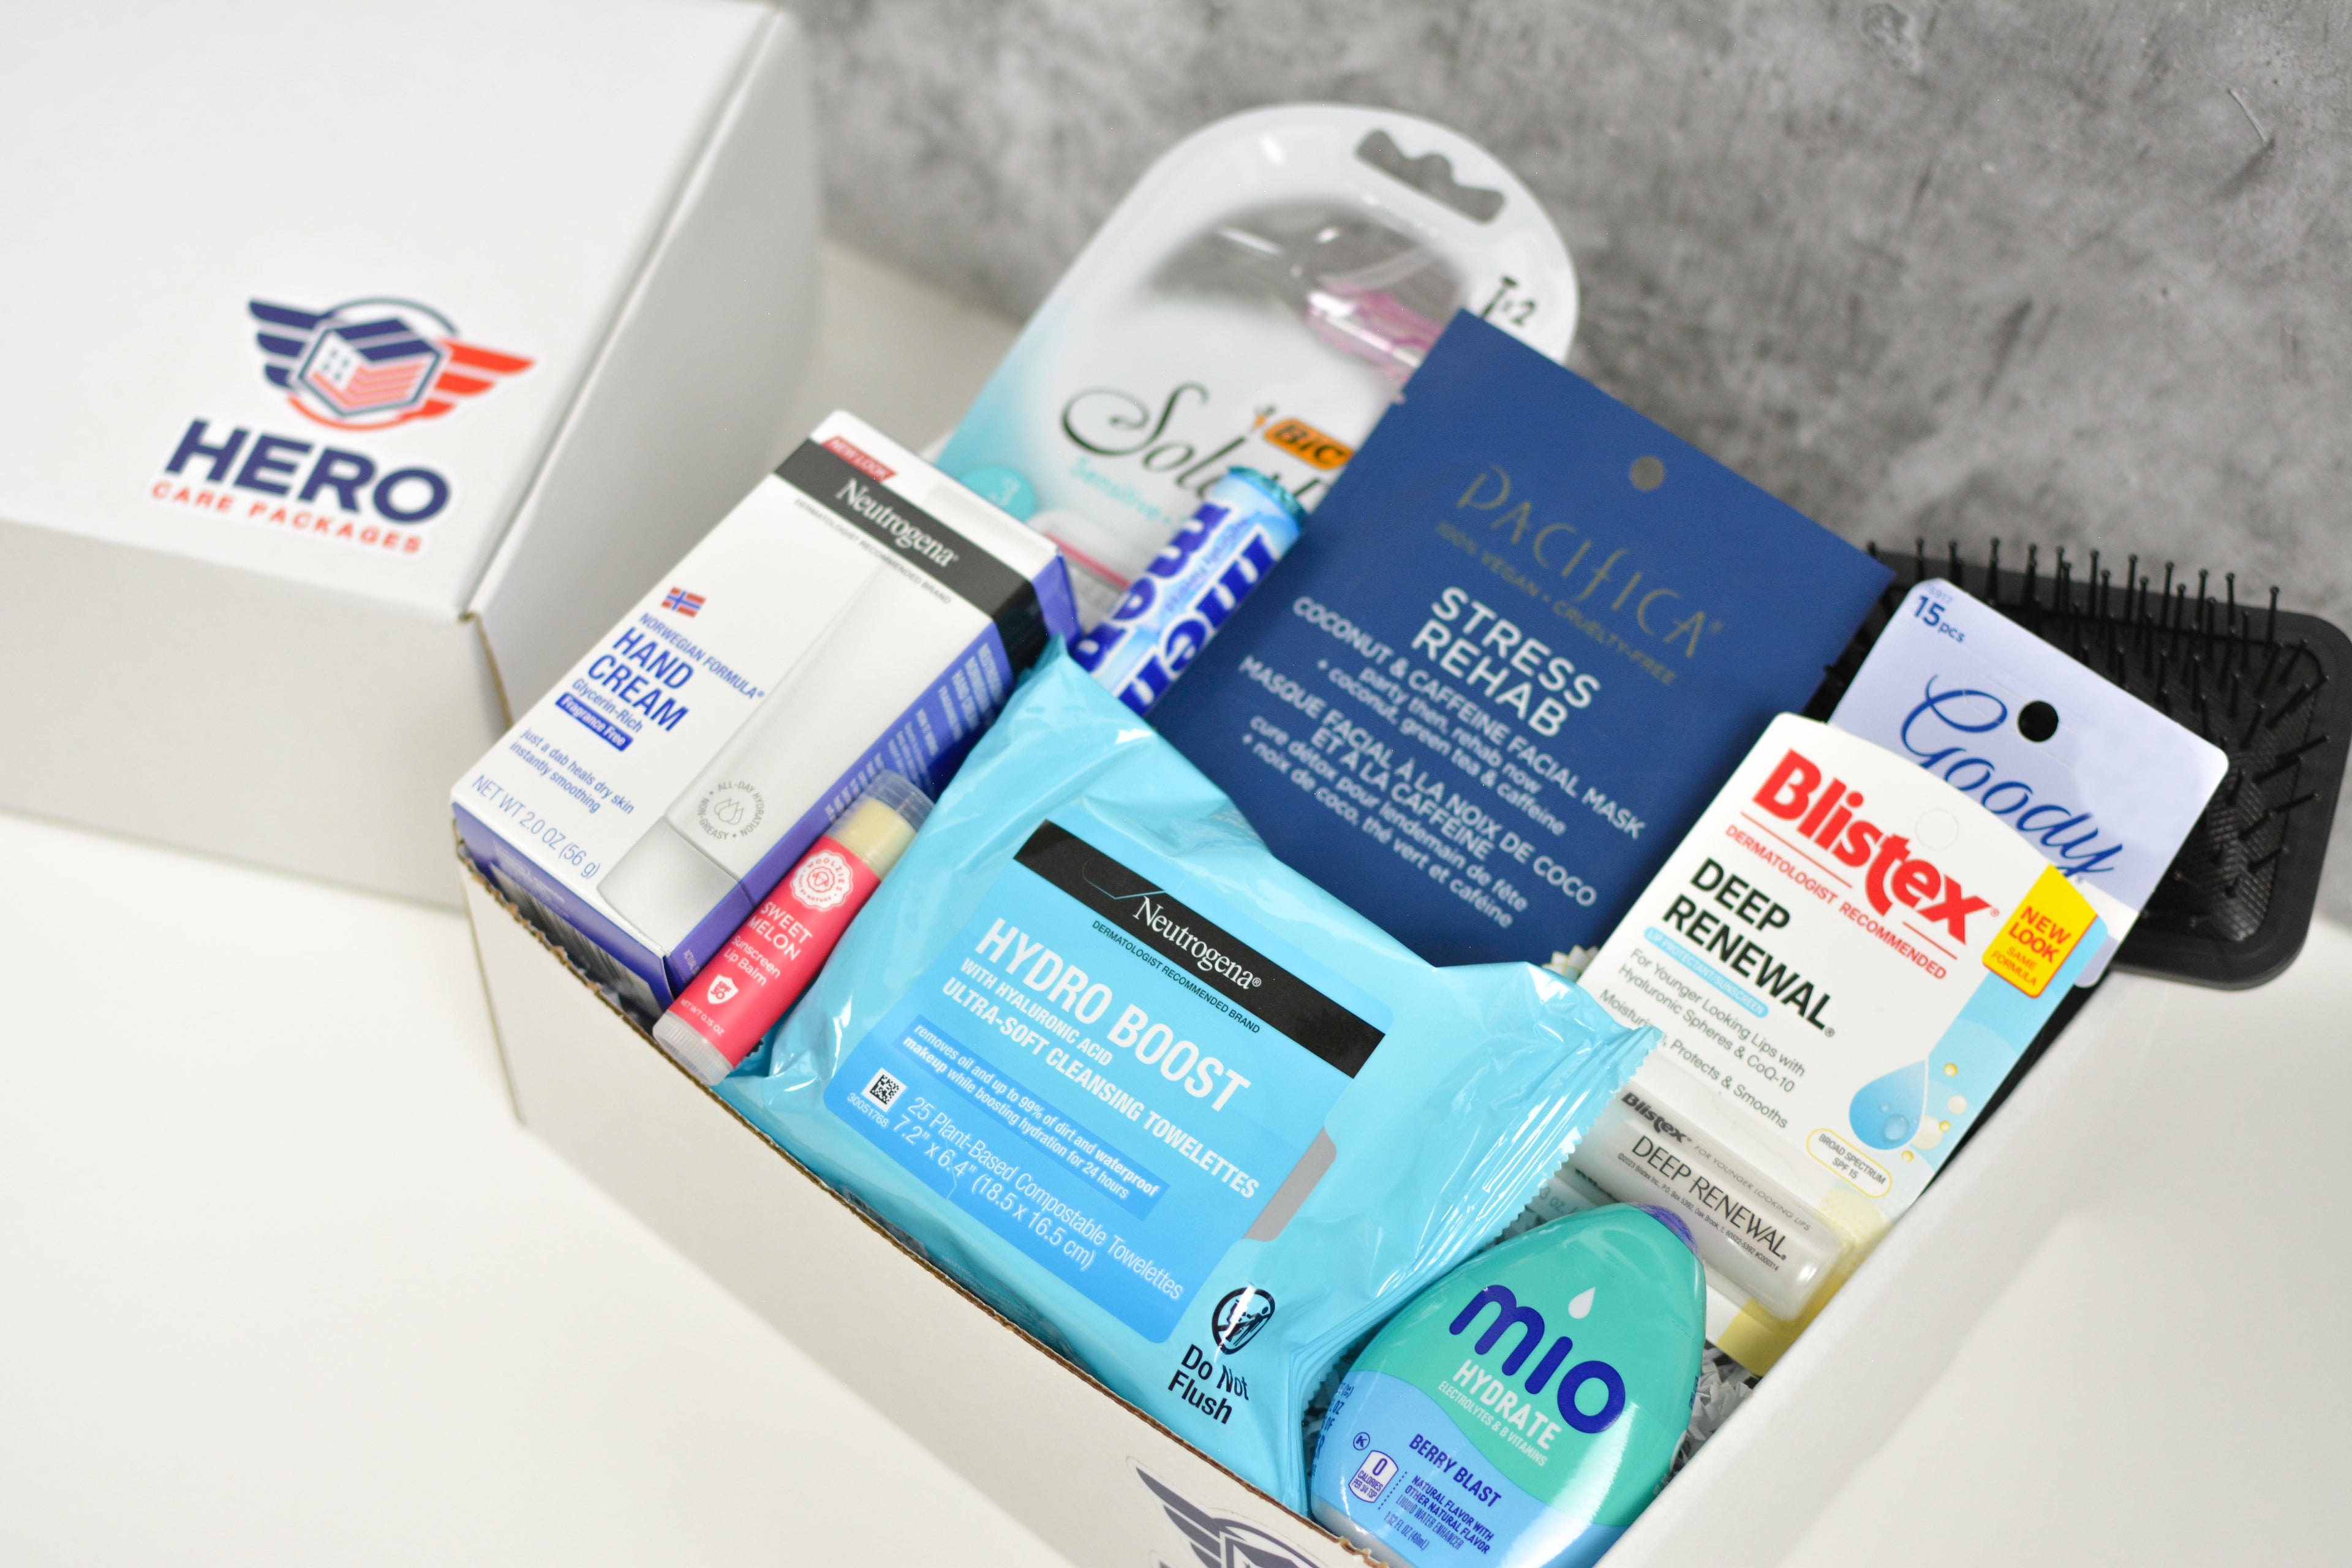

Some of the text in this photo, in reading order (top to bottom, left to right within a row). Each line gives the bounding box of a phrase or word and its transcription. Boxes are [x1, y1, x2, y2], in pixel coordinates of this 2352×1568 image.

[164, 418, 452, 524] HERO
[151, 481, 422, 554] CARE PACKAGES
[639, 612, 706, 660] NORWEGIAN
[1431, 587, 1601, 709] STRESS
[1912, 595, 1966, 643] 15 pcs
[589, 655, 689, 731] CREAM
[612, 627, 694, 690] HAND
[1411, 618, 1568, 736] REHAB
[560, 693, 627, 747] Fragrance Free
[572, 678, 643, 733] Glycerin-Rich
[1292, 595, 1646, 839] COCONUT CAFFEINE FACIAL MASK
[1359, 668, 1544, 793] party rehab now
[510, 741, 601, 813] instantly smoothing
[520, 728, 635, 814] just dab heals dry skin
[1238, 656, 1326, 718] MASQUE
[1322, 709, 1394, 771] FACIAL
[1414, 771, 1446, 800] LA
[1446, 793, 1503, 840] NOIX
[1499, 832, 1534, 864] DE
[1532, 856, 1597, 907] COCO
[1250, 715, 1467, 869] cure pour lendemain
[1311, 728, 1344, 754] ET
[1359, 762, 1390, 791] LA
[1400, 718, 1567, 836] green caffeine
[1901, 673, 2123, 878] Goody
[472, 774, 566, 850] NET WT 2.0 OZ
[1253, 741, 1430, 869] noix vert
[807, 858, 844, 891] WOOLZIES
[1690, 857, 1790, 931] DEEP
[1725, 824, 1947, 980] DERMATOLOGIST RECOMMENDED
[732, 934, 782, 979] Sunscreen
[747, 915, 801, 961] MELON
[760, 901, 813, 944] SWEET
[2007, 946, 2037, 970] SAME
[2008, 922, 2060, 963] LOOK
[2020, 905, 2071, 944] NEW
[737, 960, 767, 987] Balm
[1091, 920, 1261, 1034] DERMATOLOGIST RECOMMENDED BRAND
[1991, 951, 2036, 986] FORMULA
[960, 957, 1112, 1066] WITH HYALURONIC ACID
[975, 917, 1251, 1112] HYDRO BOOST
[1618, 964, 1796, 1093] Hyaluronic Spheres CoQ-10
[1630, 948, 1806, 1077] For Younger Looking Lips with
[847, 1093, 889, 1128] 30051768
[903, 1037, 1130, 1199] makeup while boosting hydration for 24 hours
[913, 1025, 1160, 1197] removes oil and up 99% dirt and waterproof
[943, 977, 1259, 1199] ULTRA-SOFT CLEANSING TOWELETTES
[1671, 1039, 1719, 1080] Protects
[1733, 1081, 1789, 1129] Smooths
[1632, 1134, 1692, 1180] DEEP
[1714, 1159, 1754, 1189] YOUNGER
[1819, 1134, 1886, 1185] BROAD SPECTRUM
[1832, 1158, 1858, 1179] SPF 15
[908, 1097, 1185, 1300] 25 Plant-Based Compostable Towelettes
[971, 1174, 1019, 1212] (18.5
[1028, 1212, 1066, 1246] 16.5
[1063, 1240, 1097, 1271] cm)
[1182, 1344, 1250, 1401] Do Not
[1449, 1284, 1626, 1434] mio
[1168, 1370, 1232, 1425] Flush
[1438, 1380, 1547, 1467] ELECTROLYTES VITAMINS
[1452, 1359, 1561, 1451] HYDRATE
[1357, 1471, 1383, 1491] CALORIES
[1372, 1458, 1387, 1476] 0
[1409, 1433, 1501, 1508] BERRY BLAST
[1396, 1494, 1464, 1550] LIQUID WATER ENHANCER
[1405, 1485, 1490, 1554] OTHER NATURAL FLAVOR
[1412, 1475, 1494, 1541] NATURAL FLAVOR WITH
